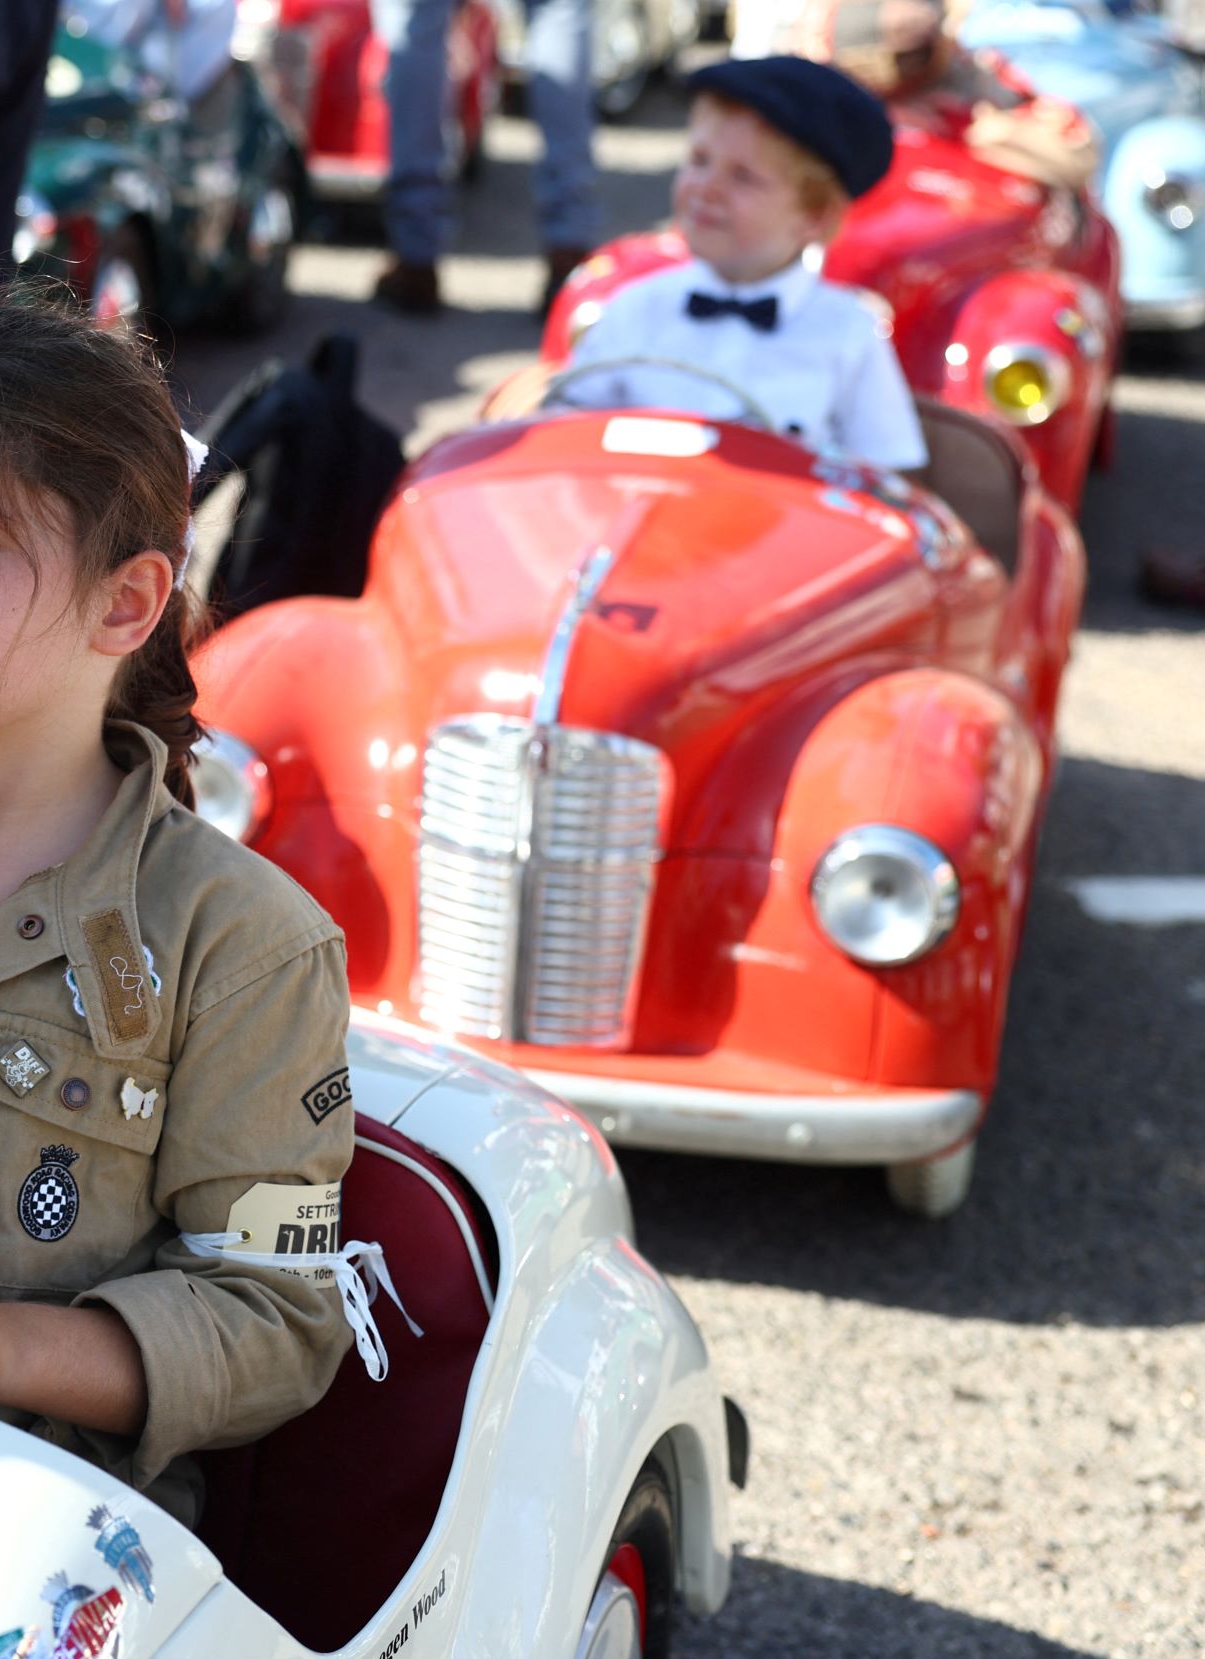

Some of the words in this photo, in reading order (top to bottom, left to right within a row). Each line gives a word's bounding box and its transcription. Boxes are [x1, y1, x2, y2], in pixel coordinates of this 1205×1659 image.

[31, 1167, 53, 1185] ROAD
[54, 1168, 75, 1197] RACING
[22, 1184, 42, 1236] GOODWOOD
[50, 1200, 76, 1237] COMPANY
[314, 1268, 334, 1280] 10th
[412, 1568, 445, 1630] Wood
